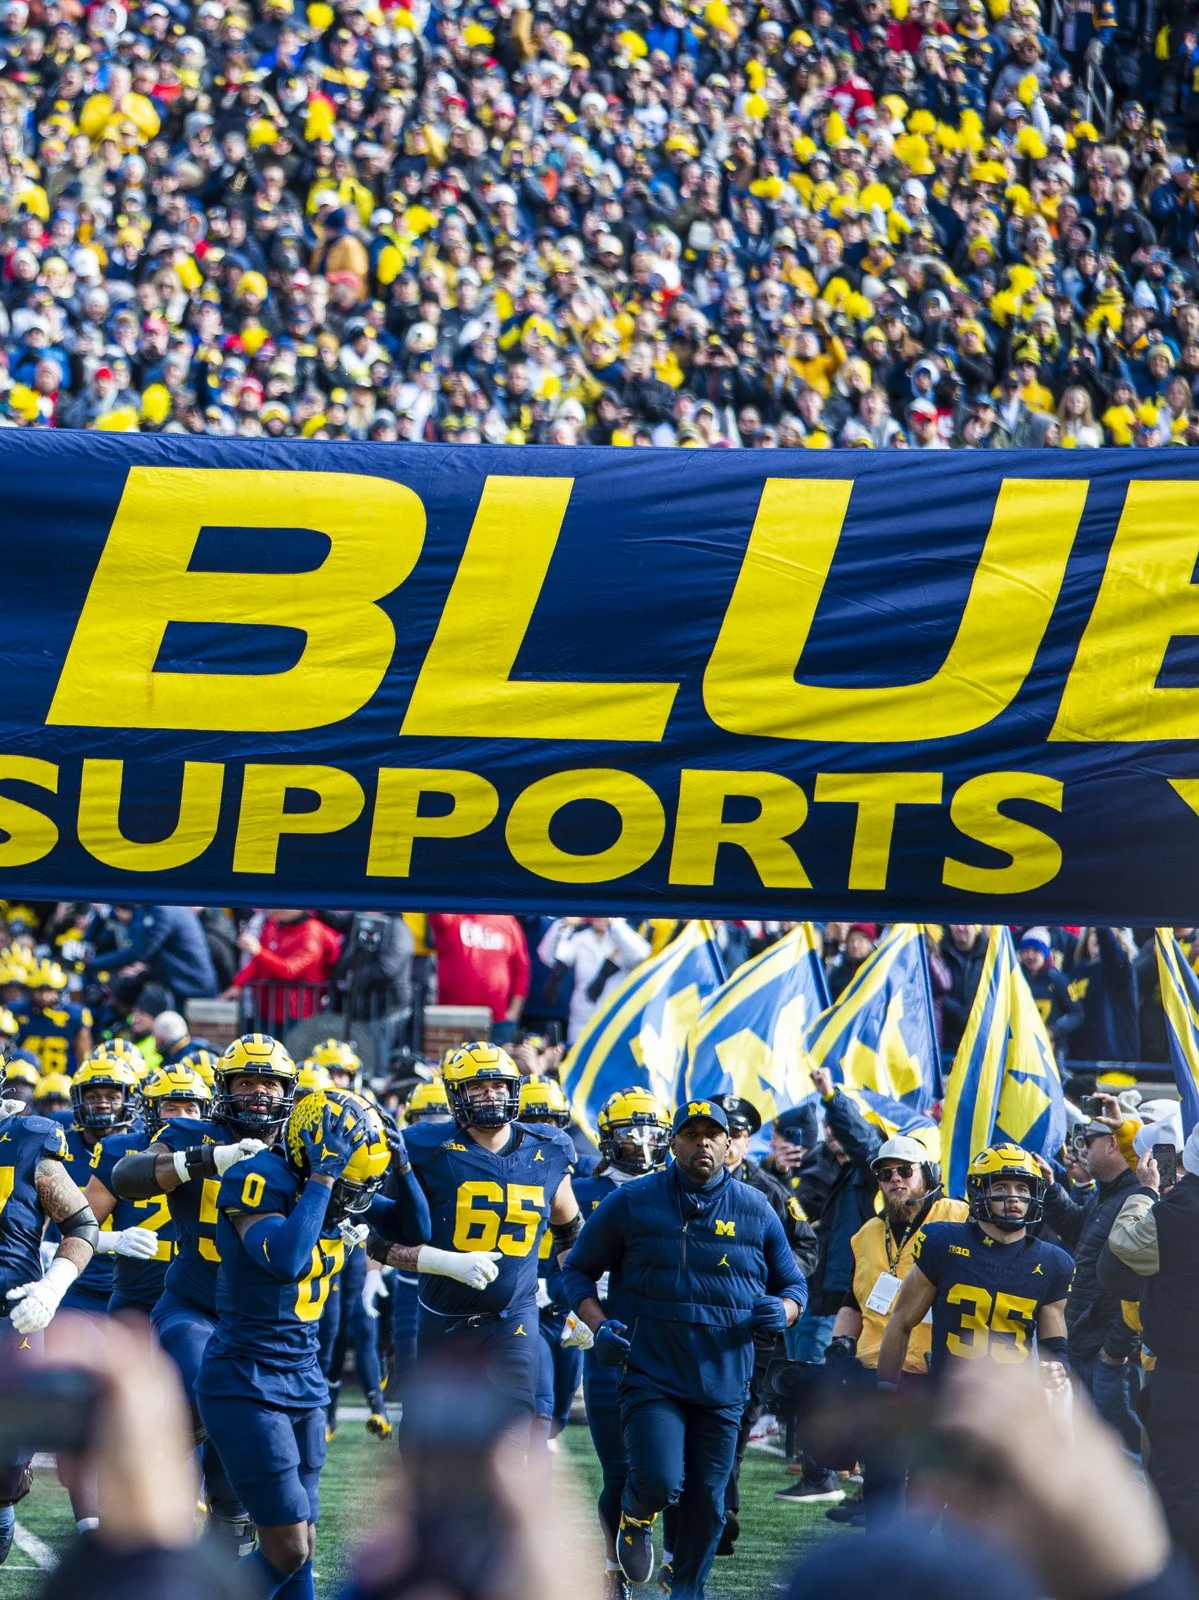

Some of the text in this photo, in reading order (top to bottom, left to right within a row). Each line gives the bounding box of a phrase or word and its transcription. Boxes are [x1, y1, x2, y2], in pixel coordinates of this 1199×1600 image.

[688, 1102, 711, 1116] M
[241, 1173, 266, 1208] 0
[453, 1181, 545, 1257] 65
[715, 1219, 736, 1237] M
[946, 1283, 1037, 1364] 35
